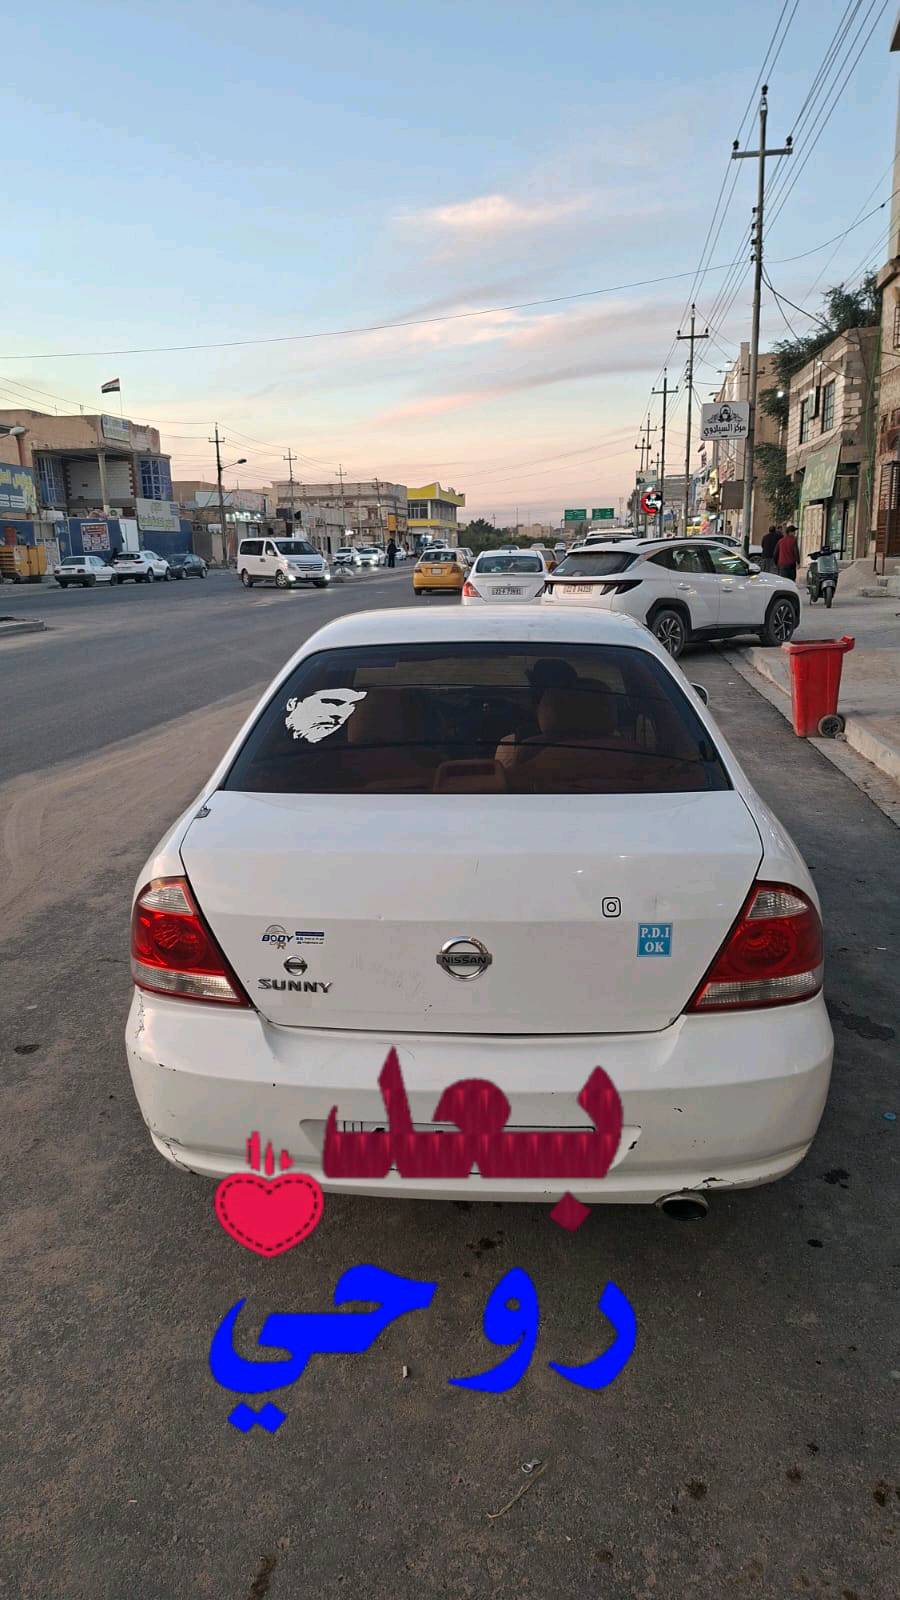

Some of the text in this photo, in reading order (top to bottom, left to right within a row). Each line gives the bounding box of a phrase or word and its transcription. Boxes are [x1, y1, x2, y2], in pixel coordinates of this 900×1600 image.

[733, 422, 746, 433] مركز
[640, 927, 670, 938] P.D.I
[262, 934, 294, 943] BODY
[644, 941, 664, 953] OK
[442, 956, 487, 964] NISSAN
[258, 978, 333, 993] SUNNY
